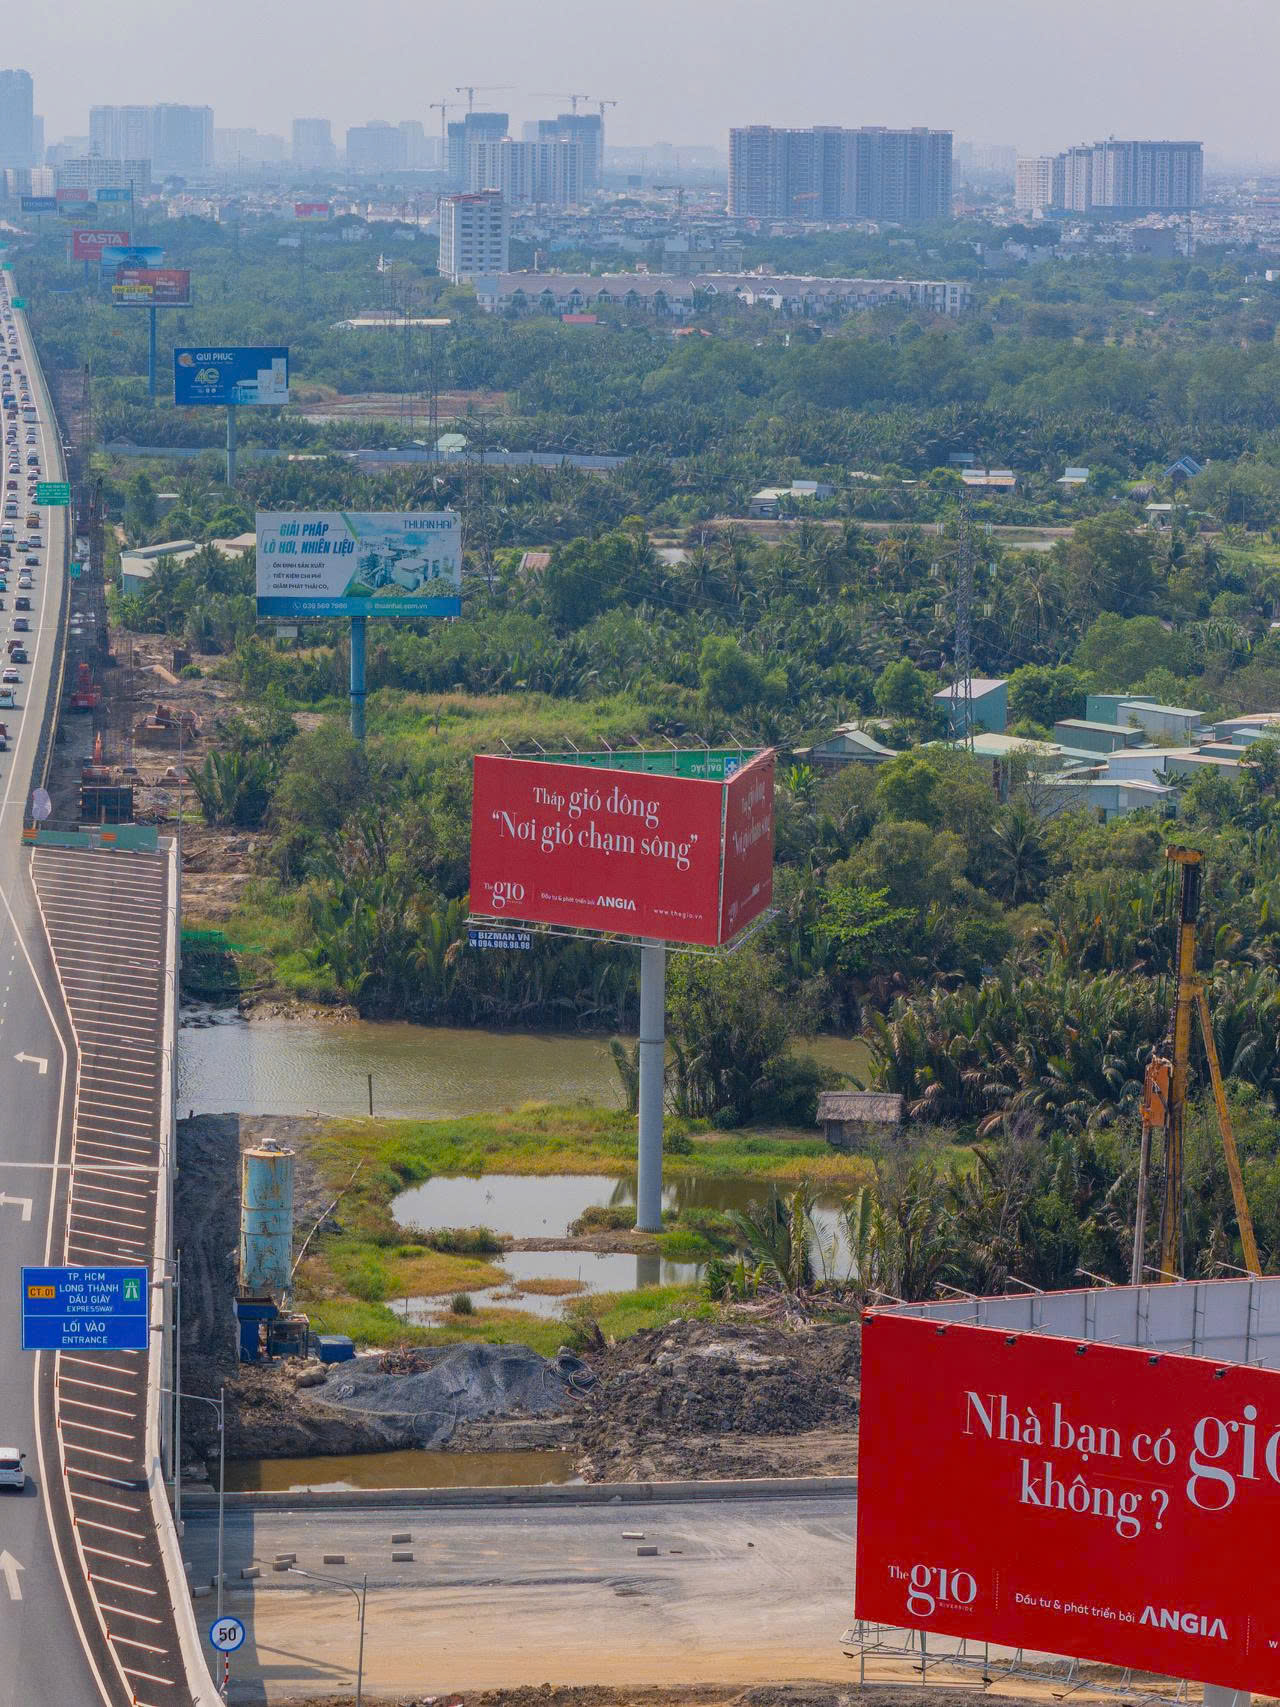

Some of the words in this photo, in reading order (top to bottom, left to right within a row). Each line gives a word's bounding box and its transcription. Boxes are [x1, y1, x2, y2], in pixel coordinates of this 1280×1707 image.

[79, 233, 122, 244] CASTA
[280, 520, 300, 536] GIẢI
[302, 521, 329, 536] PHÁP
[264, 539, 276, 554] LÒ
[279, 540, 297, 555] HƠI,
[301, 538, 331, 553] NHIÊN
[333, 539, 354, 556] LIỆU
[533, 787, 565, 811] Tháp
[568, 787, 602, 820] gió
[606, 786, 660, 829] đông
[541, 821, 573, 854] gió
[578, 821, 635, 856] chạm
[596, 896, 636, 911] ANGIA
[59, 1284, 84, 1292] LONG
[88, 1282, 119, 1292] THÀNH
[63, 1319, 80, 1332] LỐI
[85, 1321, 105, 1332] VÀO
[962, 1391, 1043, 1446] Nhà
[1052, 1402, 1122, 1462] bạn
[1132, 1428, 1176, 1466] có
[1018, 1458, 1143, 1538] không
[1150, 1488, 1169, 1530] ?
[888, 1565, 910, 1580] The
[906, 1564, 977, 1617] gió
[1015, 1592, 1036, 1606] Đầu
[1039, 1597, 1052, 1609] tư
[1053, 1599, 1061, 1610] &
[1064, 1601, 1089, 1615] phát
[1091, 1605, 1116, 1620] triển
[1119, 1611, 1136, 1623] bởi
[1139, 1606, 1228, 1640] ANGIA
[219, 1627, 236, 1641] 50
